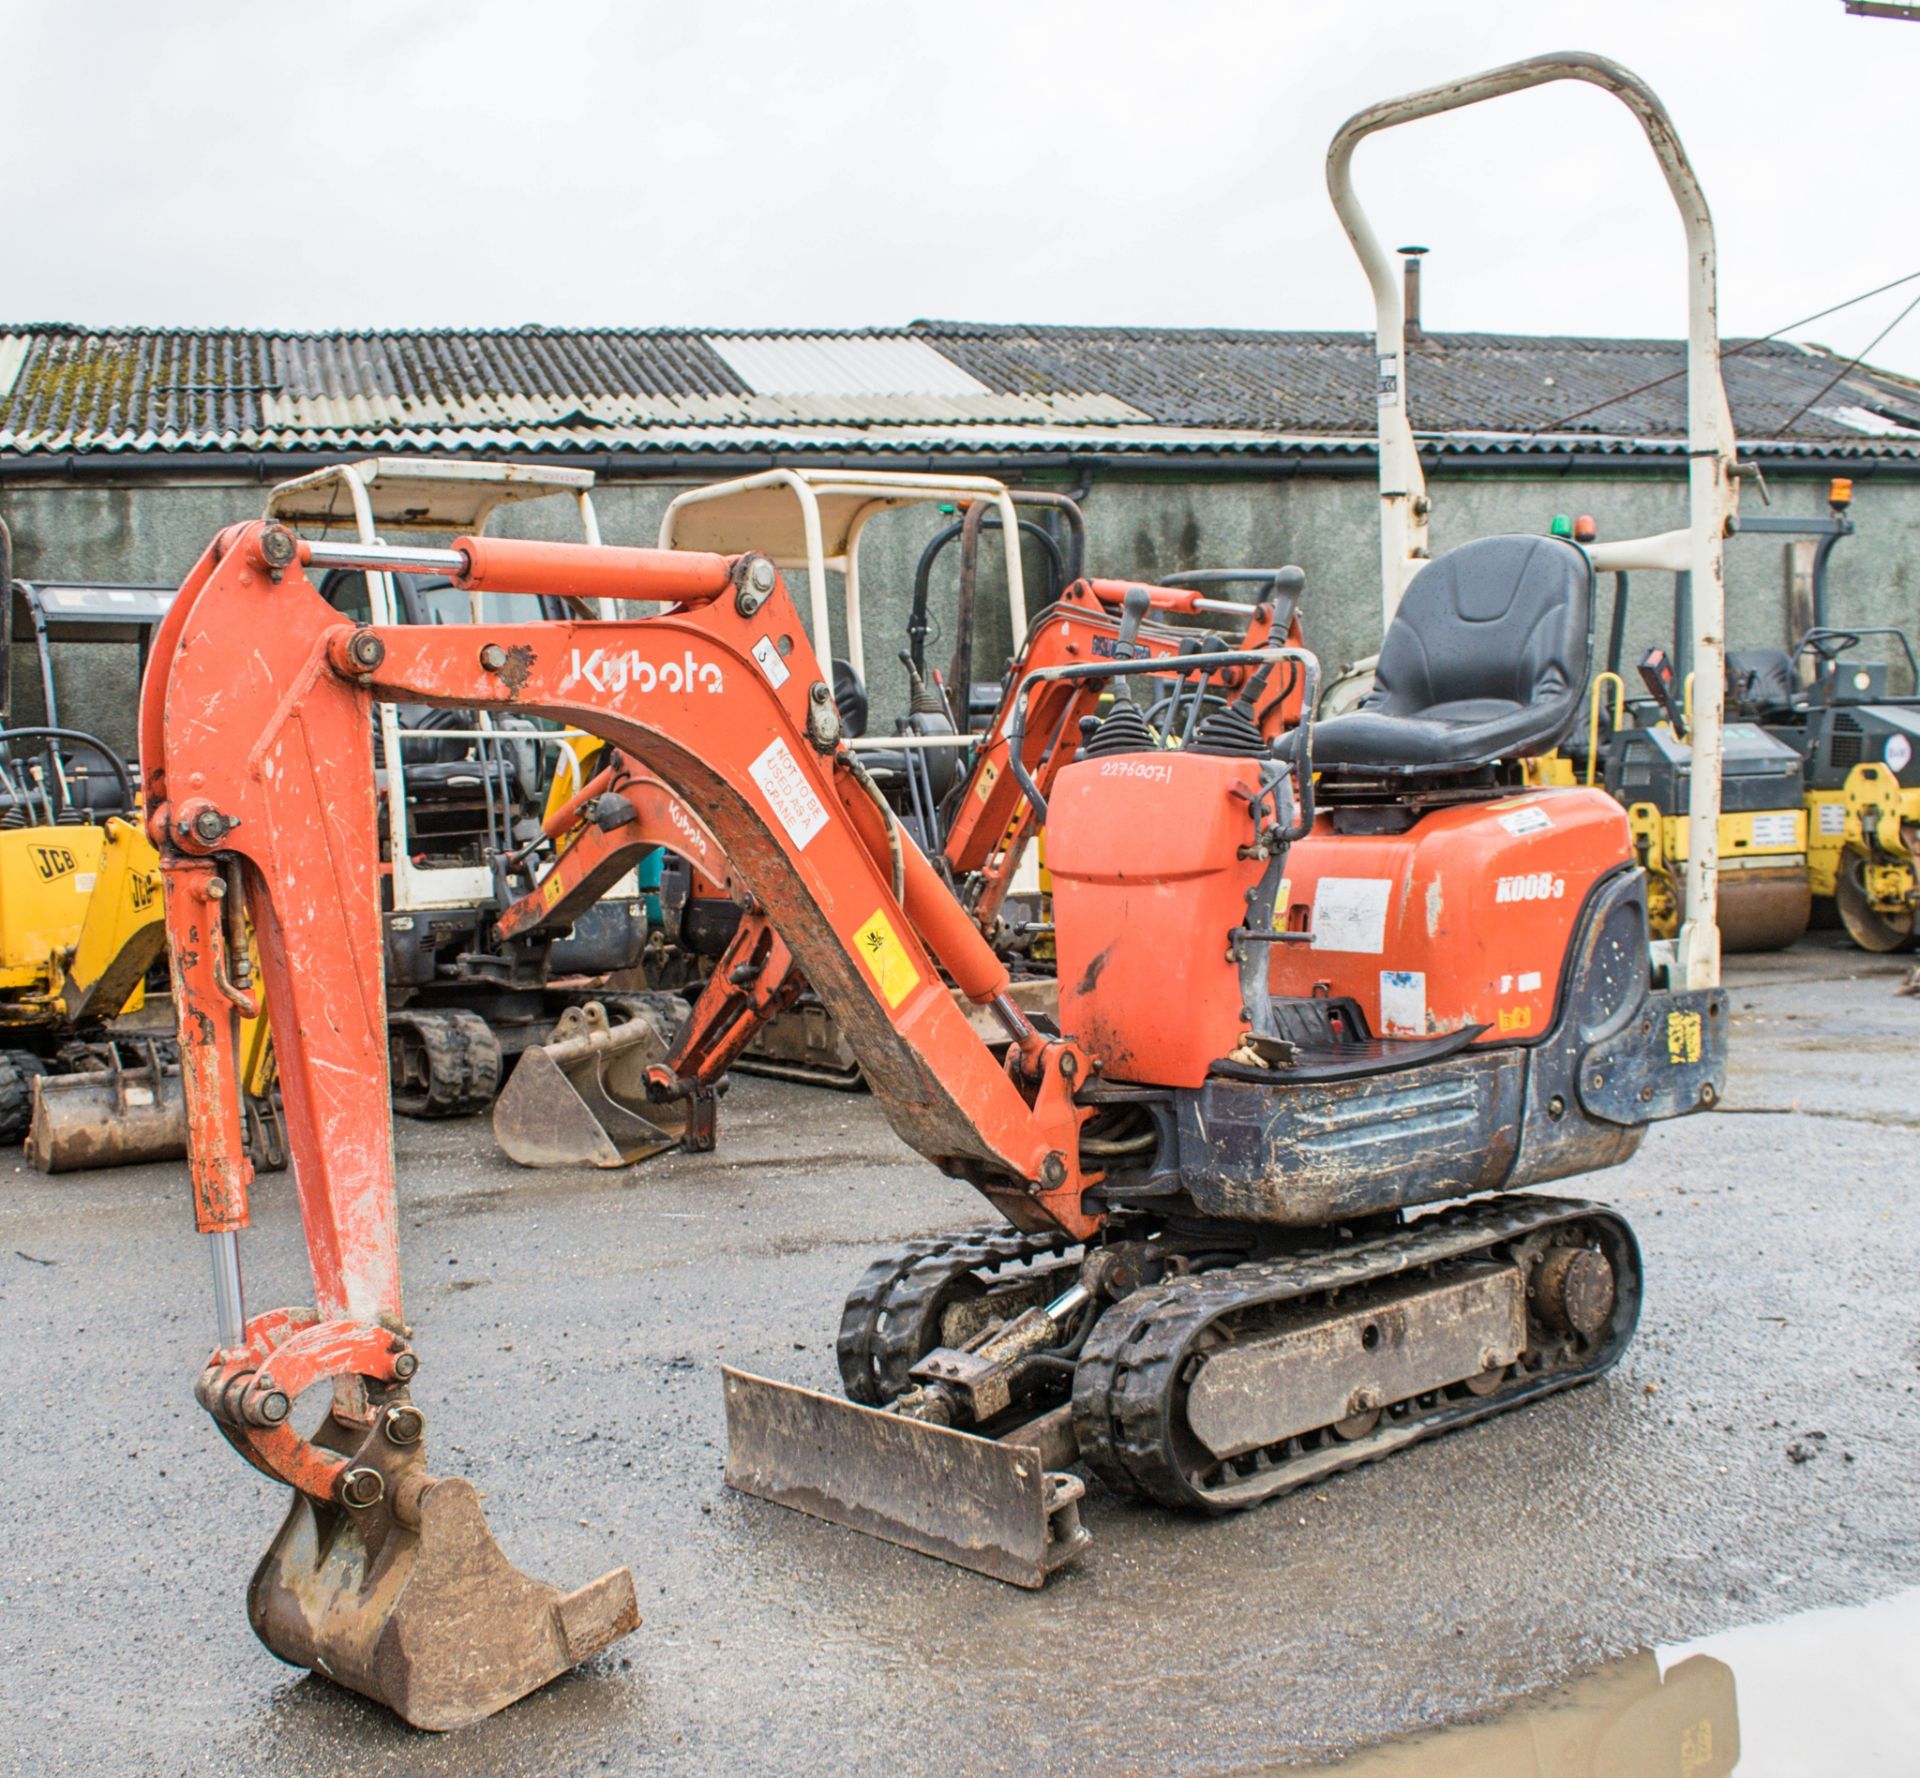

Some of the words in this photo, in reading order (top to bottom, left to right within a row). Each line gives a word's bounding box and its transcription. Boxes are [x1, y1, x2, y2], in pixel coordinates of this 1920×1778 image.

[572, 649, 723, 693] Kubota
[767, 757, 792, 796] USED
[789, 799, 805, 817] AS
[802, 818, 812, 829] A
[777, 748, 797, 776] NOT
[795, 778, 809, 798] TO
[806, 798, 822, 819] BE
[1100, 761, 1173, 784] 22760071
[765, 780, 796, 828] CRANE
[37, 848, 75, 878] JCB
